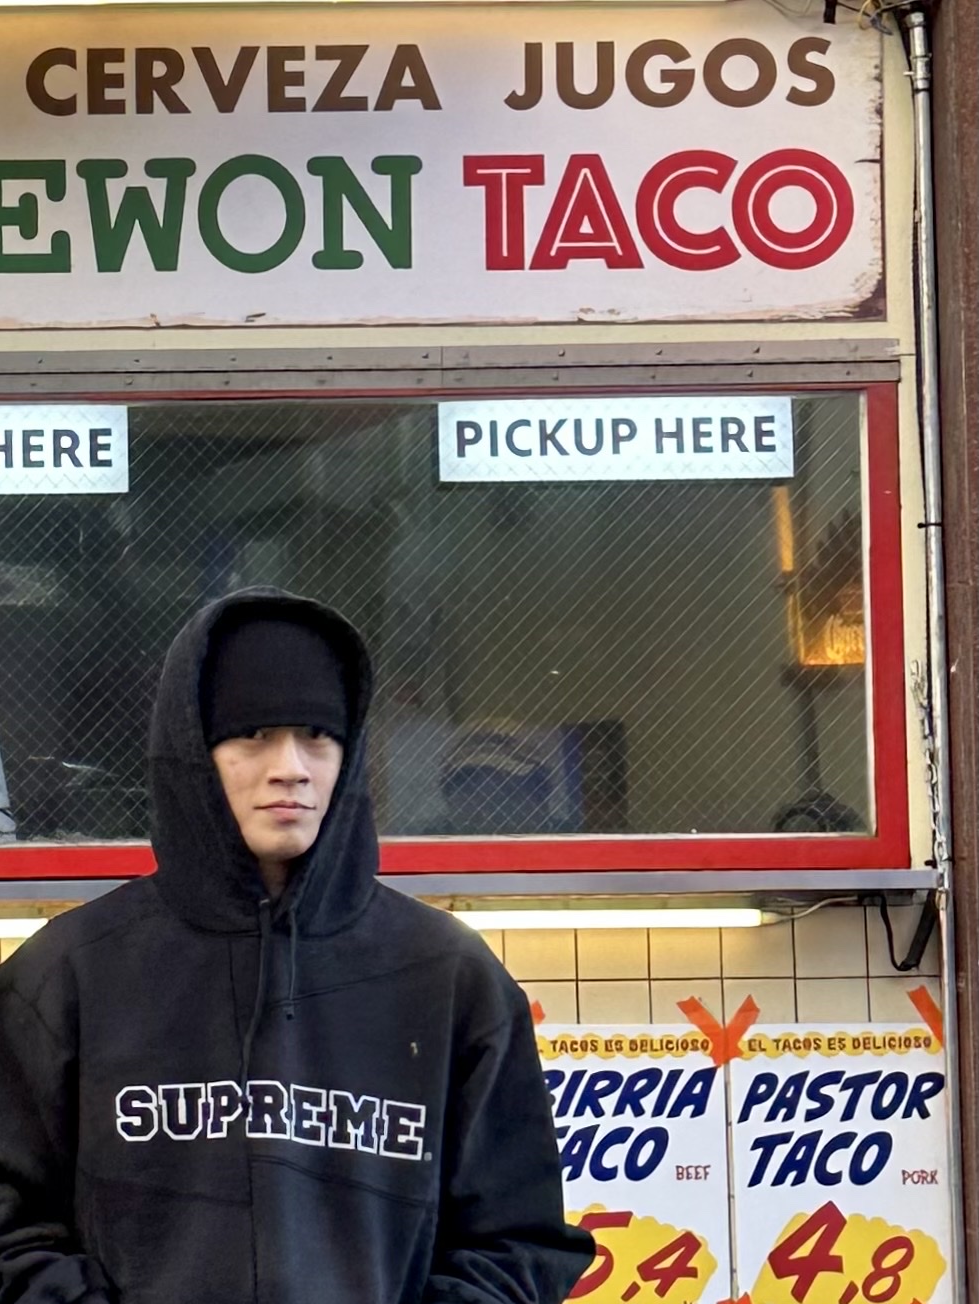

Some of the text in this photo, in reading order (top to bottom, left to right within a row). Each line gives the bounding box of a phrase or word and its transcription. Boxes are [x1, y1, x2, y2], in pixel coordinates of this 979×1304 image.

[26, 43, 442, 117] CERVEZA
[504, 37, 835, 110] JUGOS
[462, 148, 854, 271] TACO
[456, 415, 776, 458] PICKUP HERE
[550, 1039, 598, 1053] TACOS
[604, 1039, 623, 1053] ES
[629, 1038, 710, 1053] DELICIOSO
[748, 1035, 932, 1052] EL TACOS ES DELICIOSO
[115, 1080, 426, 1161] SUPREME
[737, 1070, 945, 1124] PASTOR
[555, 1124, 711, 1182] ACO BEEF
[747, 1129, 938, 1187] TACO PORK
